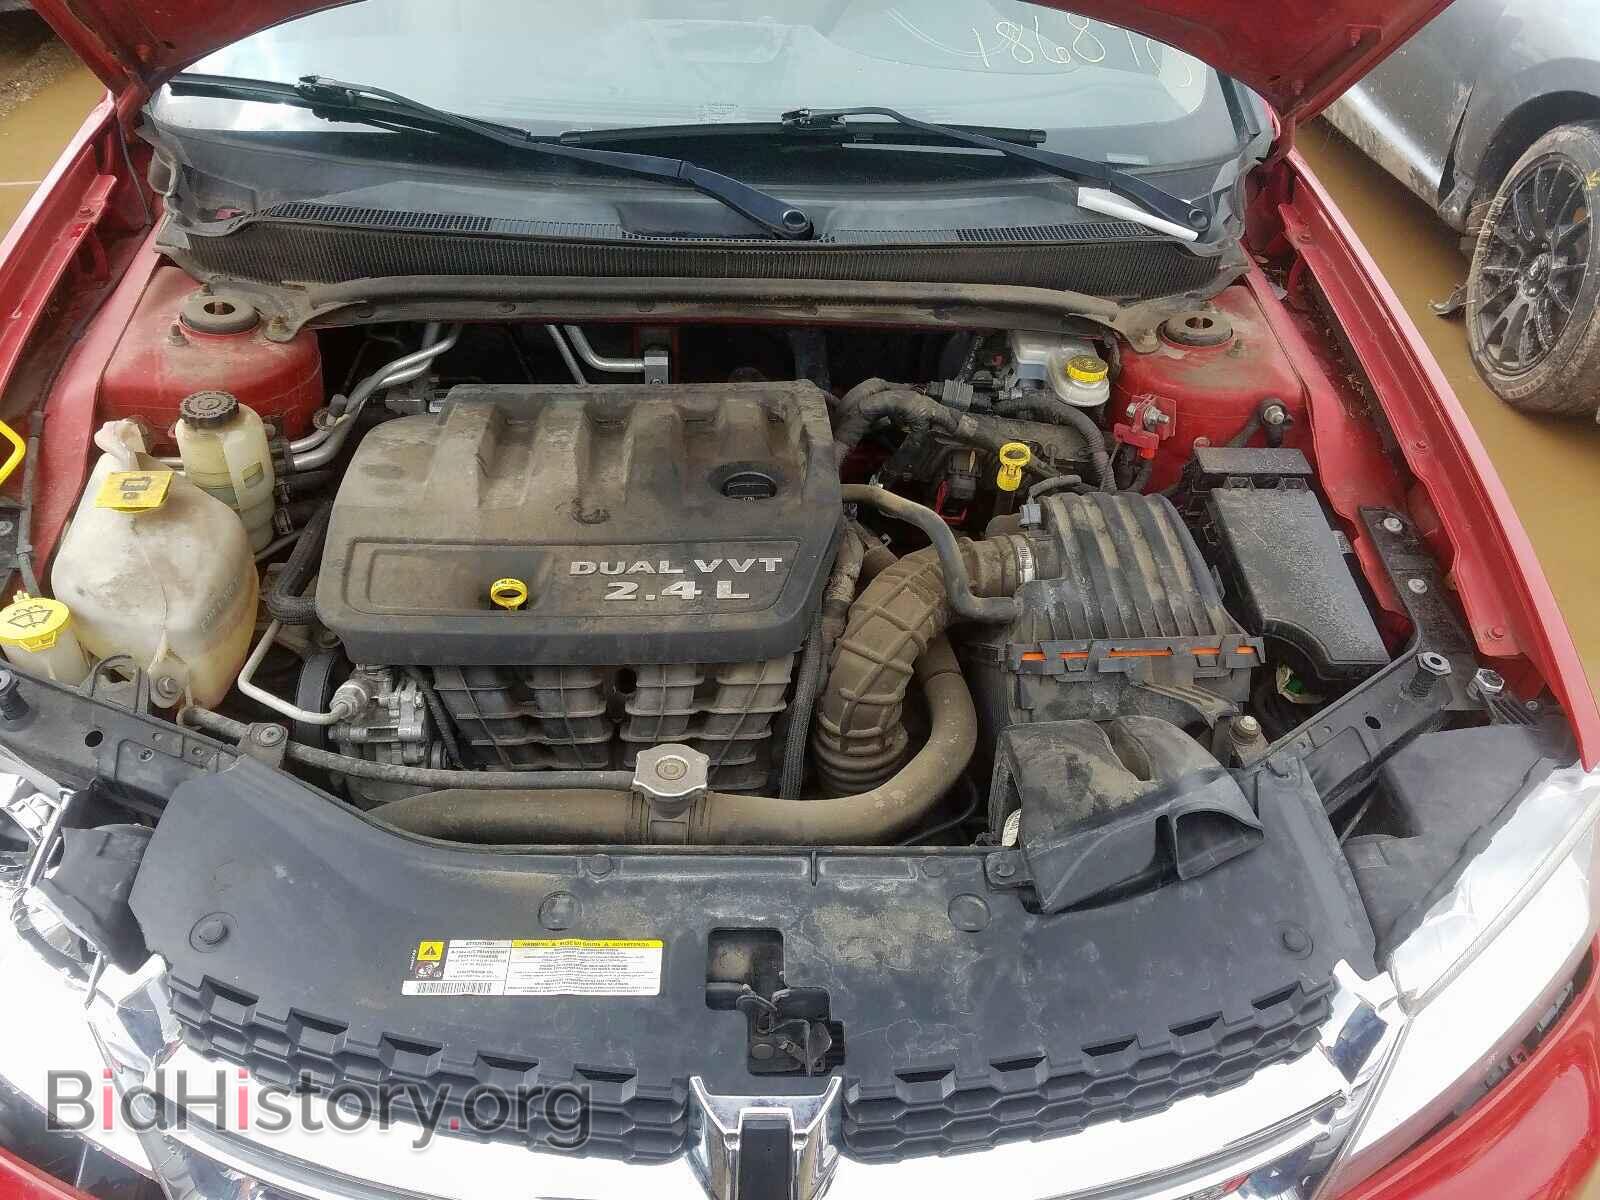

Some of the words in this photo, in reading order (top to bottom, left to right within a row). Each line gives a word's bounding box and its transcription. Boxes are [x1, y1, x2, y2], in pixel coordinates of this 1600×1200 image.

[569, 560, 685, 575] DUAL
[694, 557, 783, 573] VVT
[604, 581, 703, 601] 2.4
[716, 580, 750, 599] L
